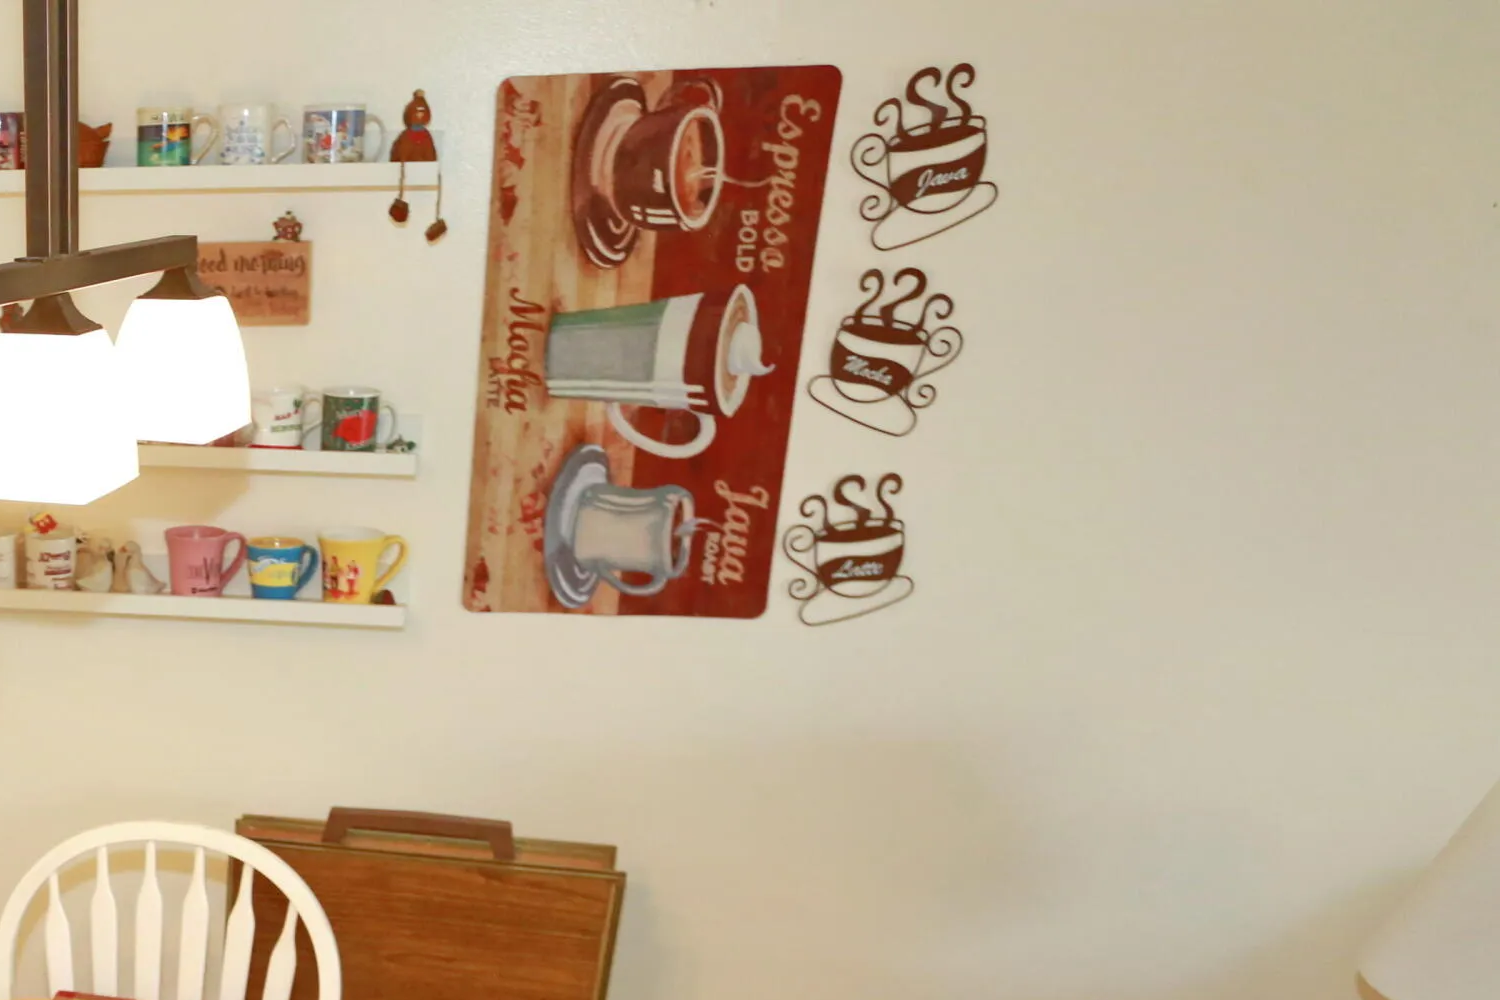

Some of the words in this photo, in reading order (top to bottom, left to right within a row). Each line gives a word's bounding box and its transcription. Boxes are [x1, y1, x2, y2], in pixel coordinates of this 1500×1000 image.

[760, 94, 821, 273] Espresso
[915, 168, 968, 198] Java
[735, 209, 760, 273] BOLD
[504, 287, 546, 415] Mocha
[842, 355, 893, 386] Mocha
[700, 531, 721, 585] ROAST
[713, 479, 770, 585] Java
[831, 559, 884, 579] Latte
